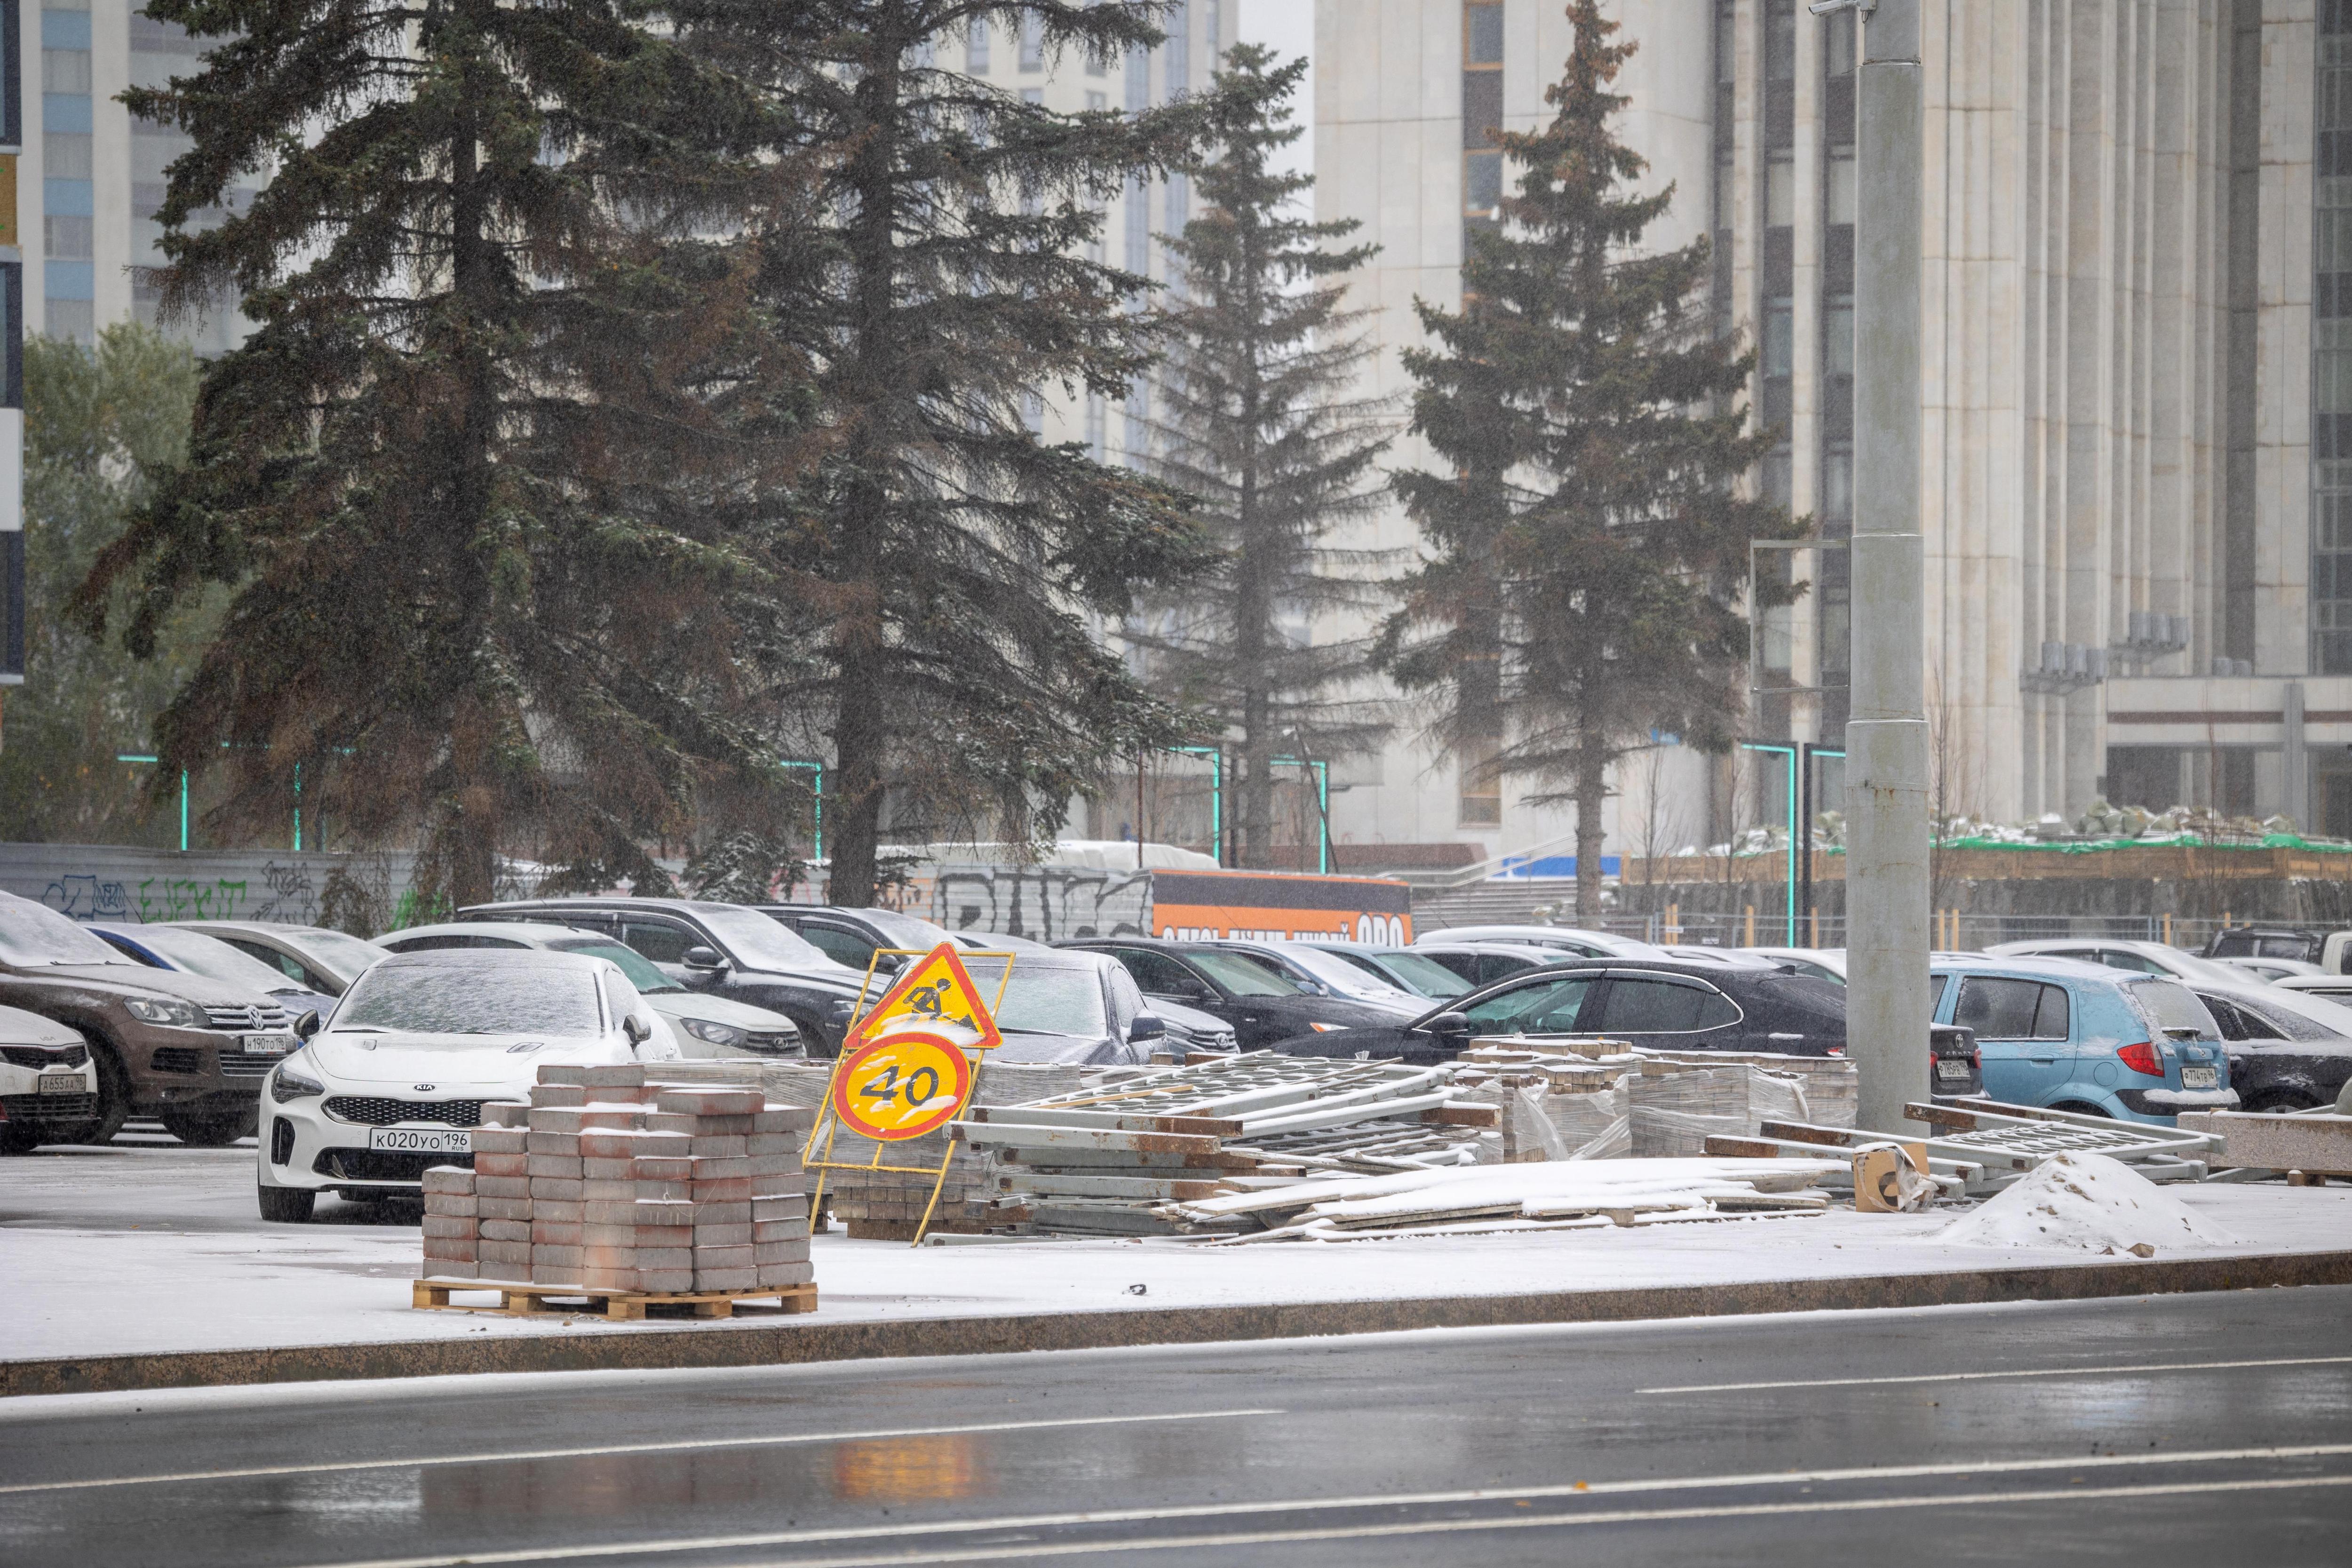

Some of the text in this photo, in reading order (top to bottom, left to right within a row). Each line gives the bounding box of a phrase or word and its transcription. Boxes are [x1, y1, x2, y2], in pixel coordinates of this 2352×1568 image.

[859, 1066, 939, 1106] 40
[376, 1132, 468, 1149] К020УО 196
